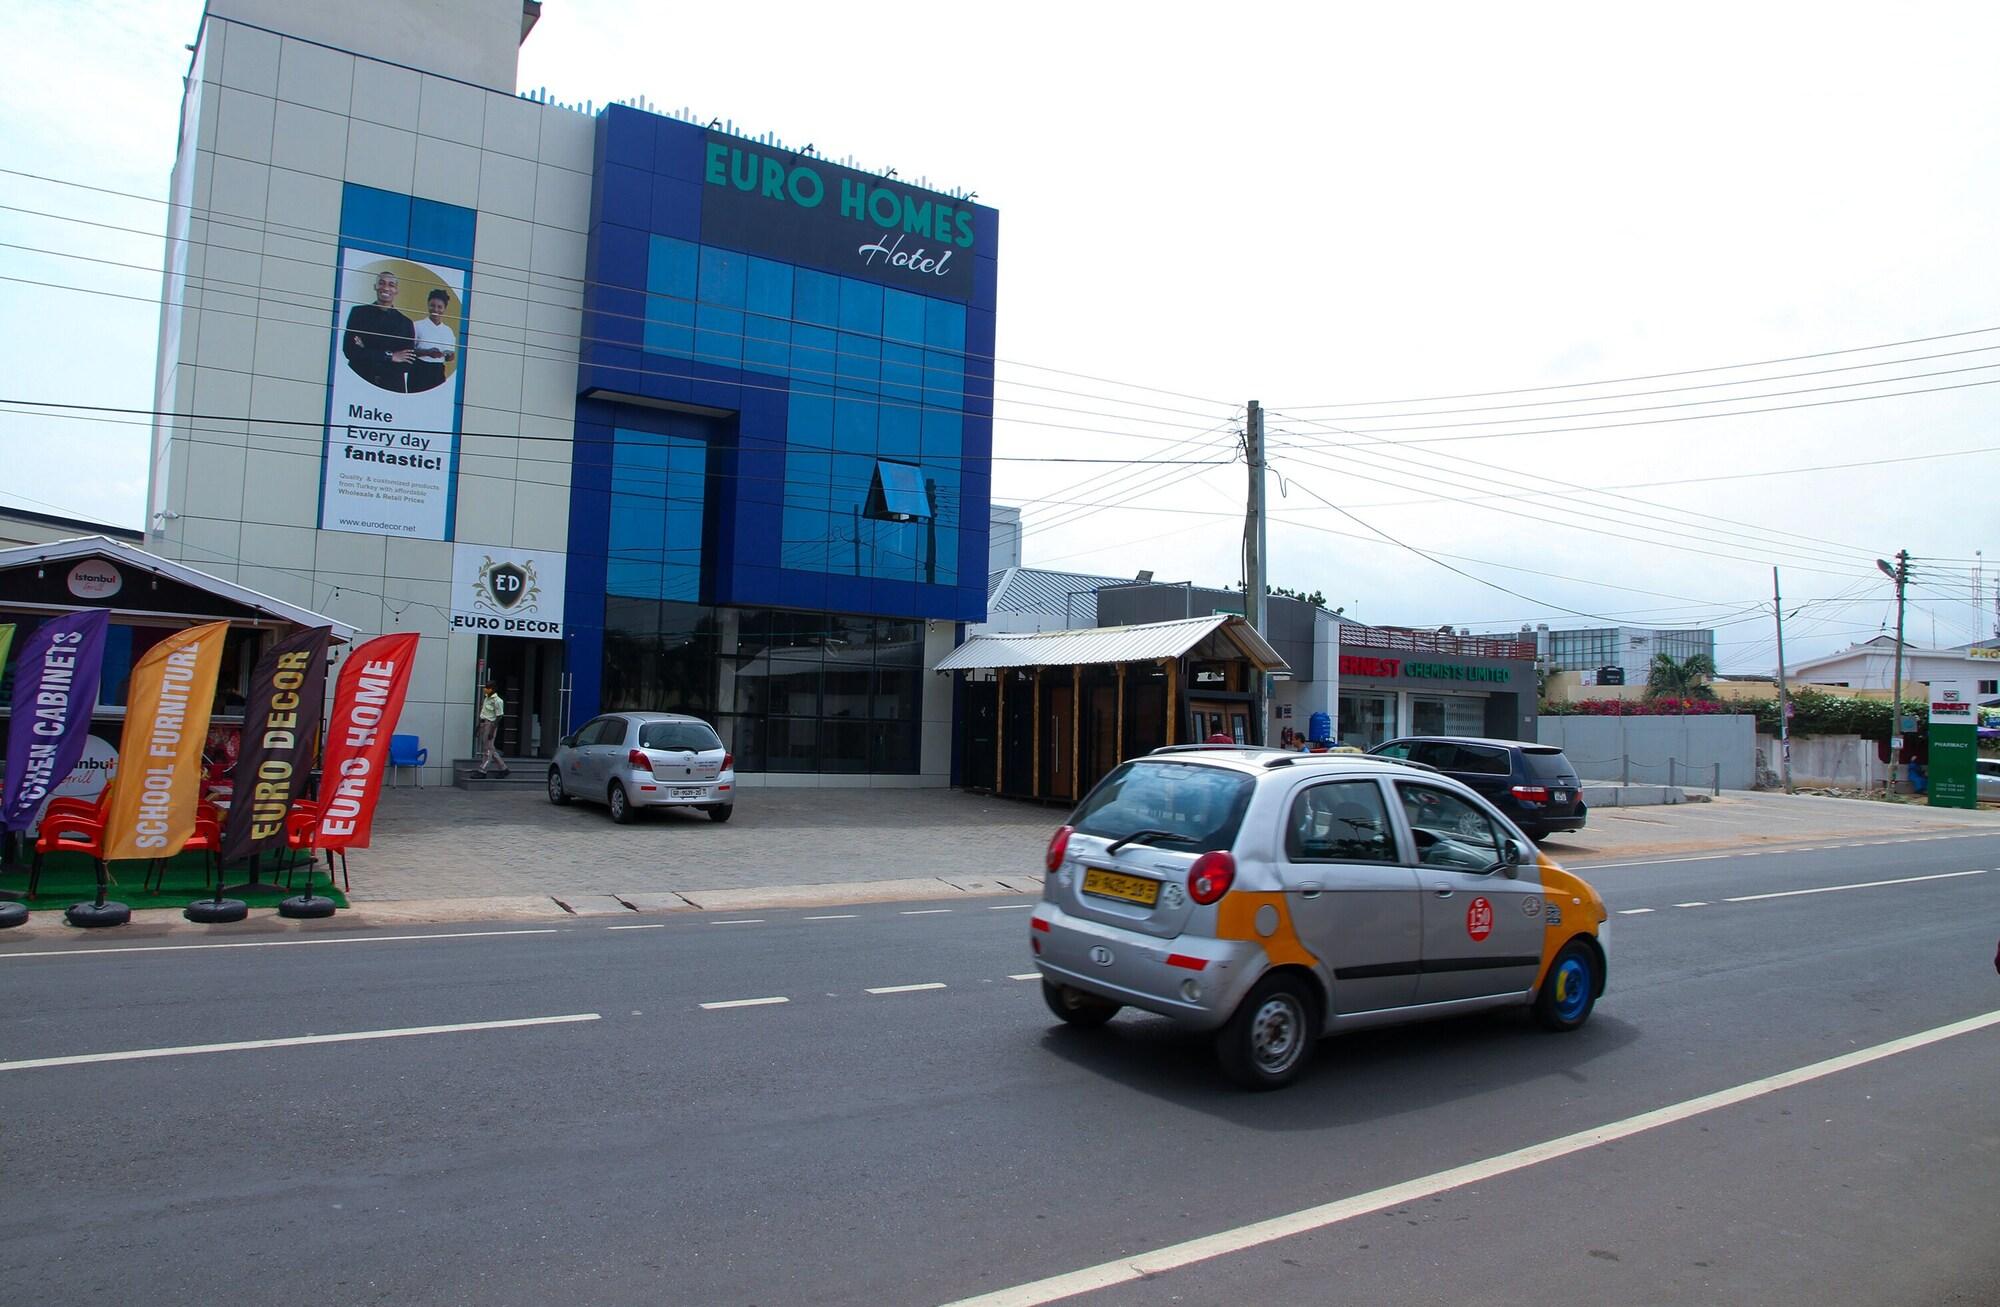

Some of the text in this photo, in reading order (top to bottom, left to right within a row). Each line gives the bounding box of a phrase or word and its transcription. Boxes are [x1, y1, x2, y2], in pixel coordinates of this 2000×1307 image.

[705, 142, 974, 248] EURO HOMES
[858, 234, 952, 276] Hotel
[348, 404, 393, 423] Make
[347, 425, 430, 451] Every day
[344, 445, 442, 470] fantastic!
[338, 480, 355, 488] from
[356, 482, 378, 492] Turkey
[339, 472, 362, 482] Quality
[373, 478, 410, 487] customized
[411, 481, 440, 490] products
[338, 488, 374, 498] Wholesale
[382, 493, 402, 502] Retail
[403, 495, 424, 504] Prices
[339, 518, 416, 532] www.eurodecor.net
[495, 574, 520, 592] ED
[453, 615, 560, 634] EURO DECOR
[1970, 648, 2000, 659] PHO
[1339, 655, 1511, 683] ERNEST CHEMISTS LIMITED
[17, 631, 83, 814] CHEN CABINETS
[251, 650, 311, 840] EURO DECOR
[321, 660, 394, 836] EURO HOME
[135, 764, 175, 848] SCHOOL
